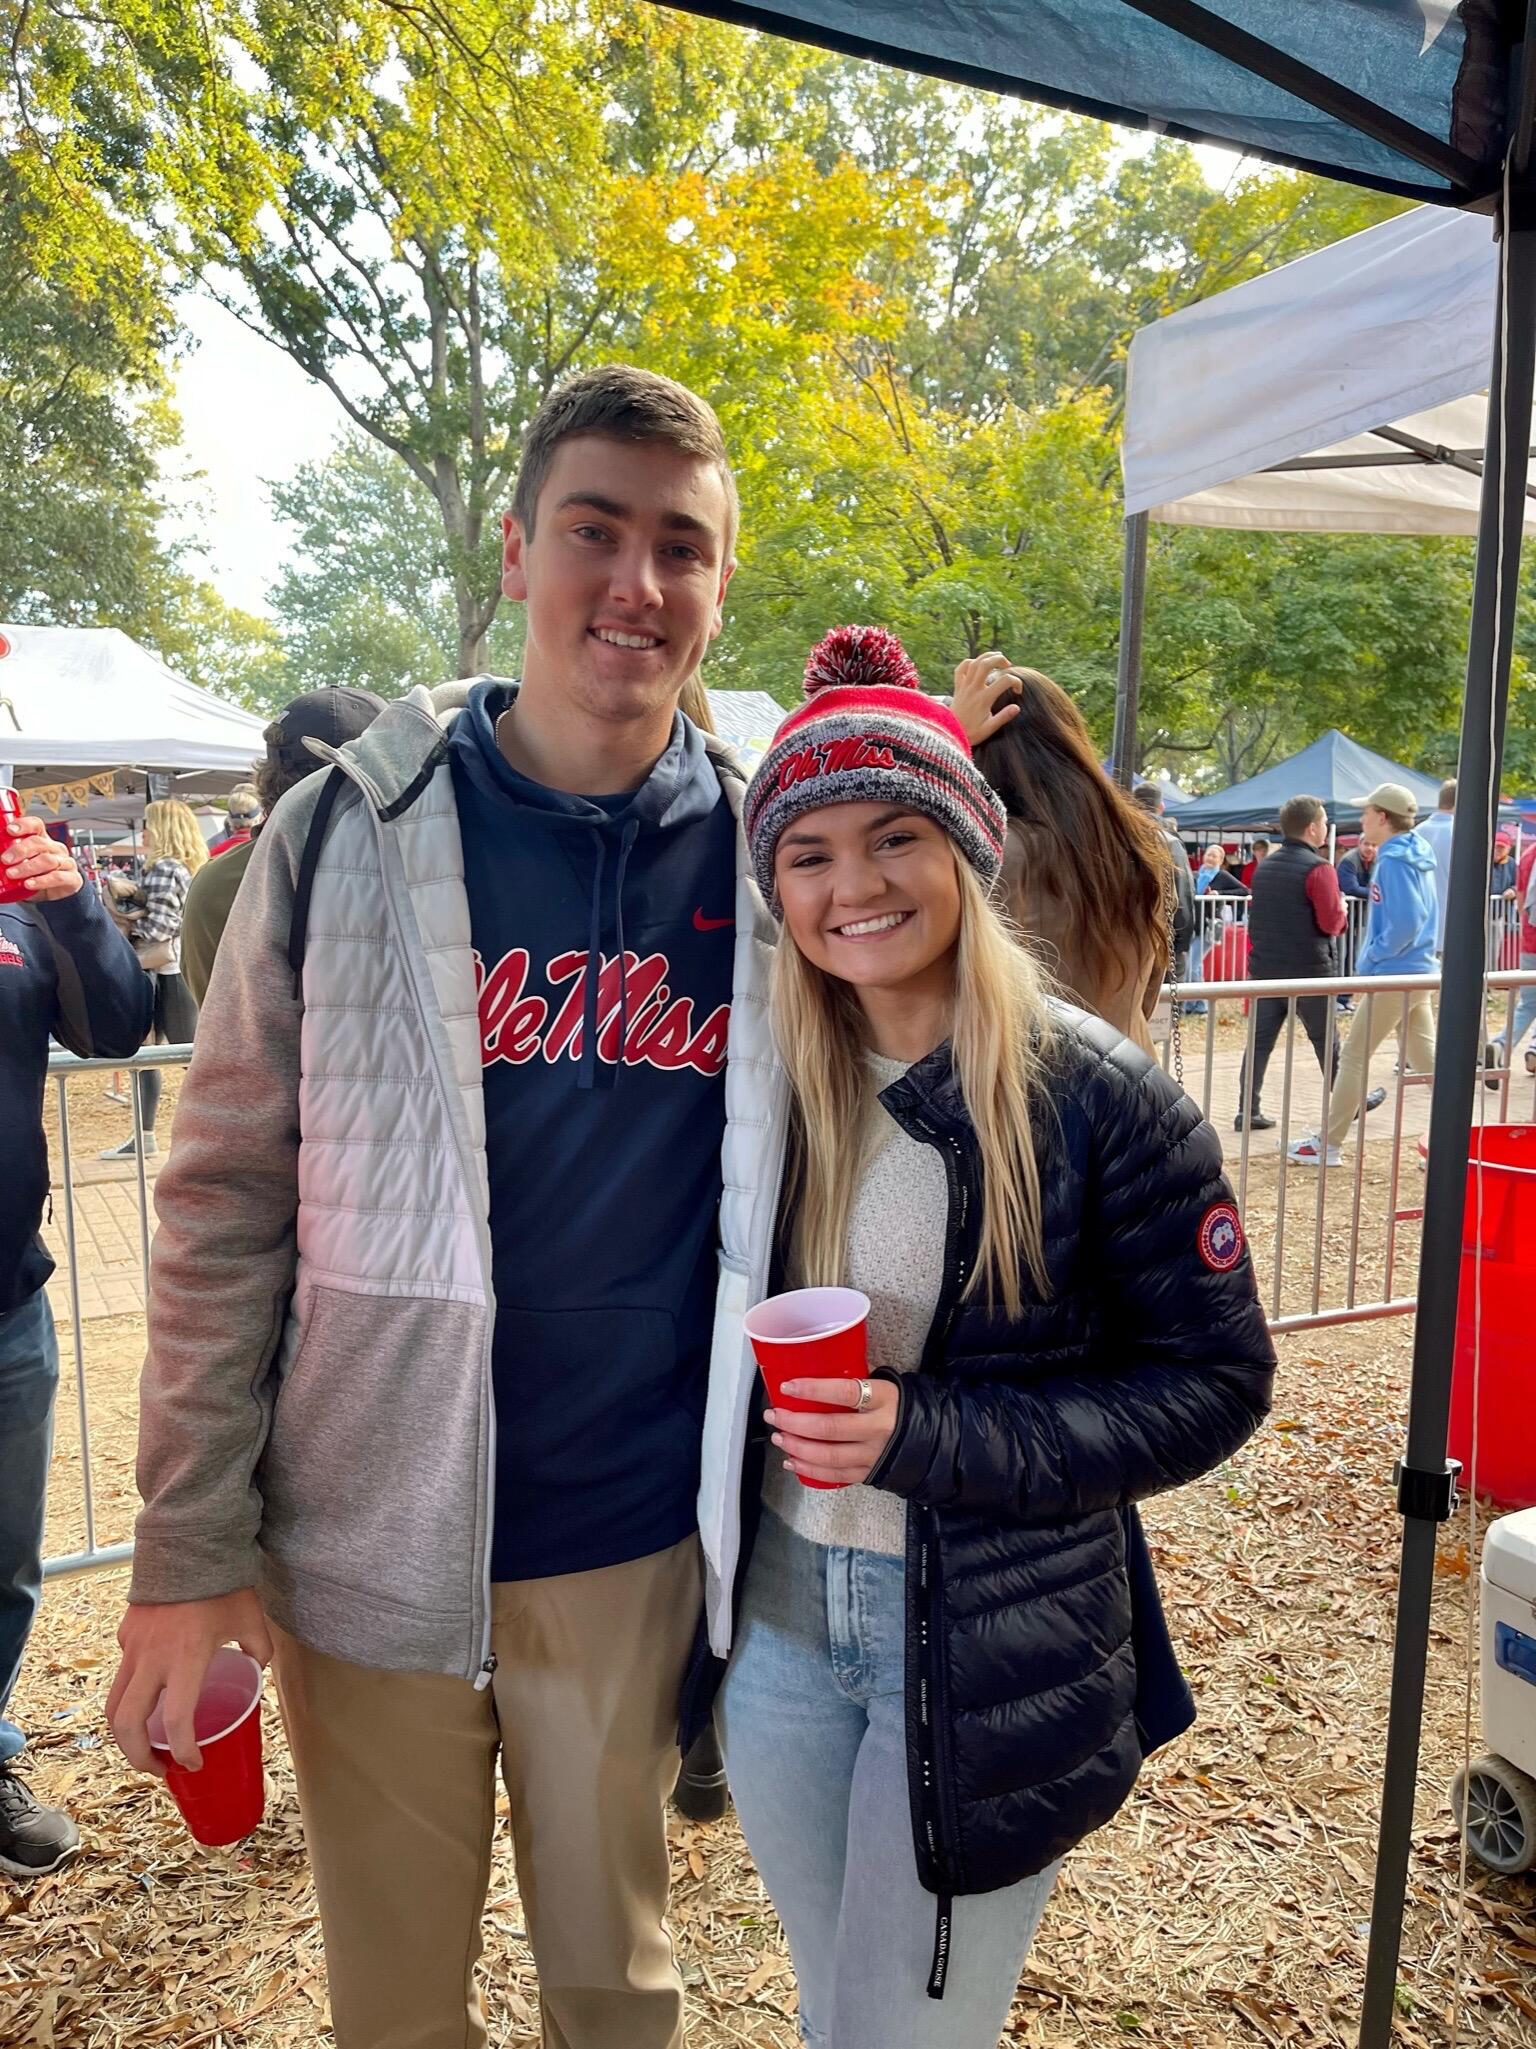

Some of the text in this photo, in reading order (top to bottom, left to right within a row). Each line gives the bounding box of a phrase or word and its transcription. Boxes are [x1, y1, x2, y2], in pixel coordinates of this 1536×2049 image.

[779, 736, 897, 792] Ole Miss
[543, 949, 732, 1077] Miss
[933, 1916, 948, 1988] CANADA GOOSE
